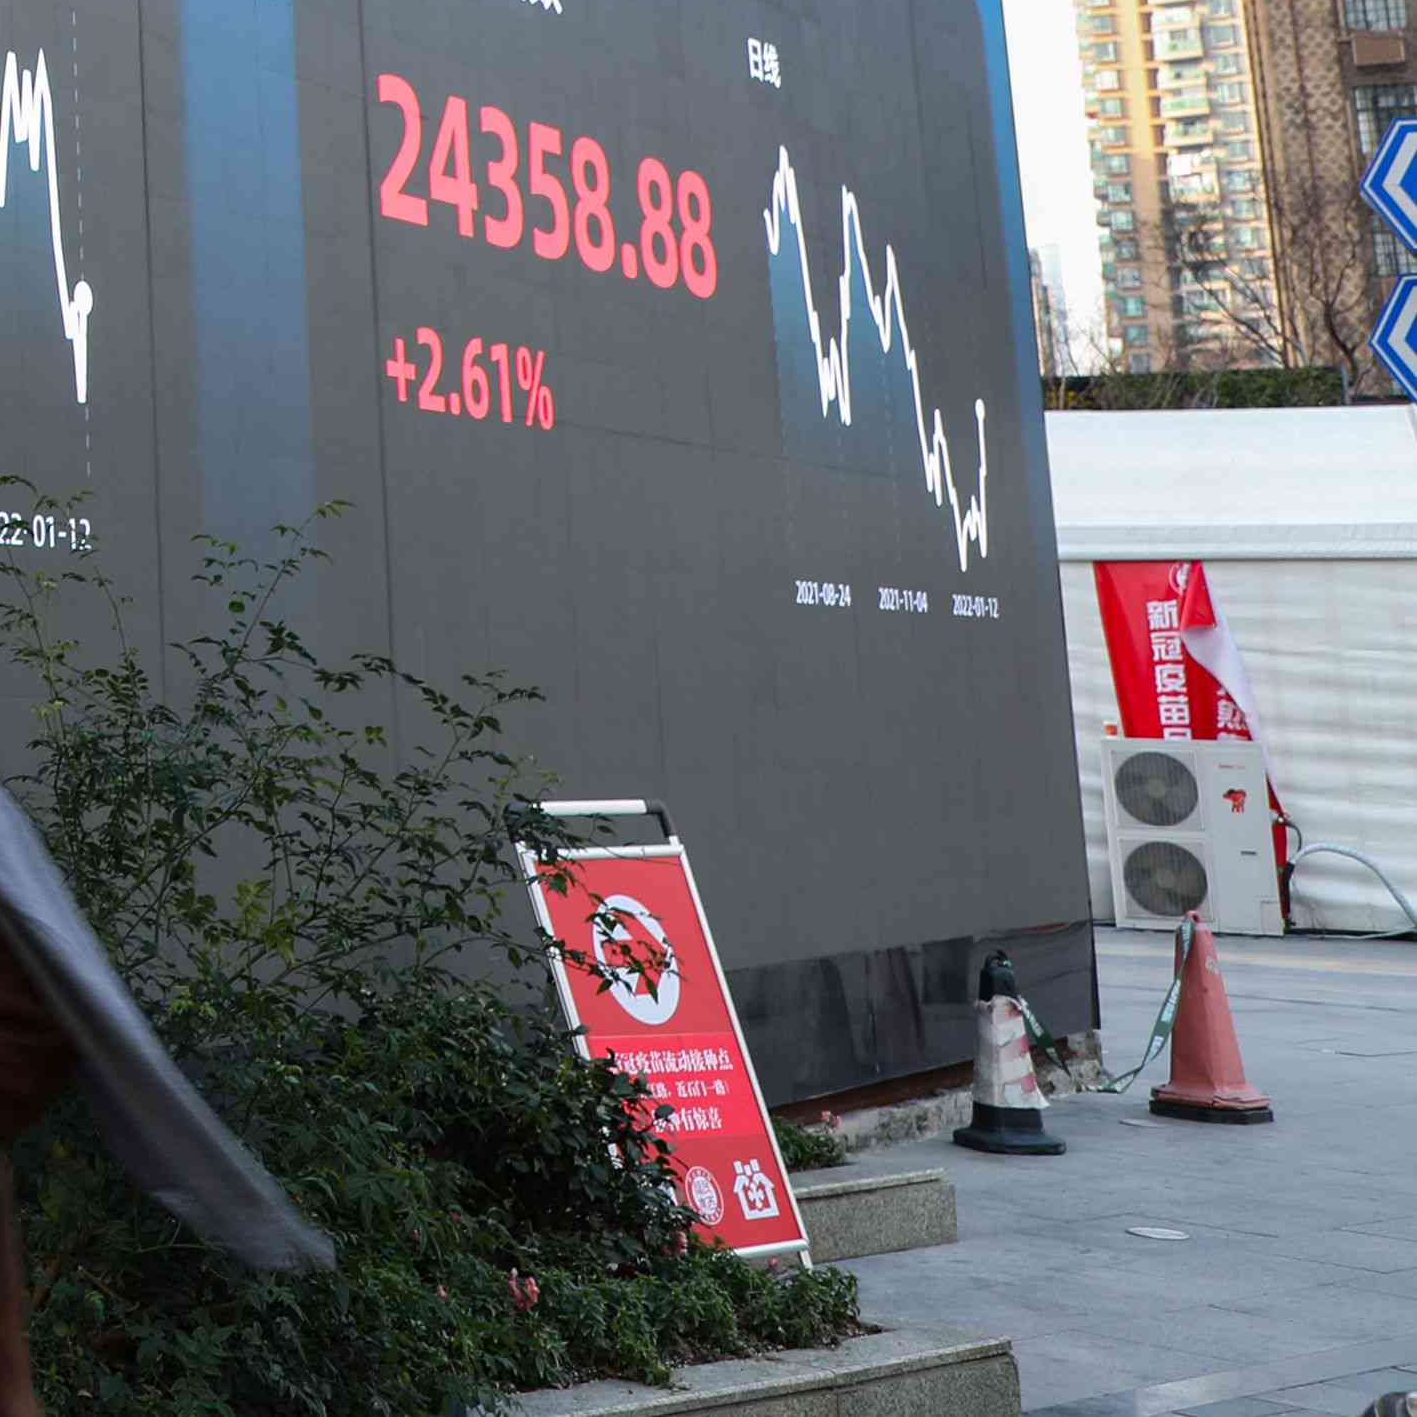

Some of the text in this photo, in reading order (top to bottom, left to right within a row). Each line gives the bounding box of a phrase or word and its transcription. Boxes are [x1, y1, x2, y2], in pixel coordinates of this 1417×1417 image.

[747, 36, 782, 89] 日线
[377, 73, 719, 300] 24358.88
[385, 326, 555, 430] +2.61%
[795, 580, 852, 607] 2021-08-24
[878, 587, 929, 613] 2021-11-04
[952, 594, 1000, 619] 2022-01-12
